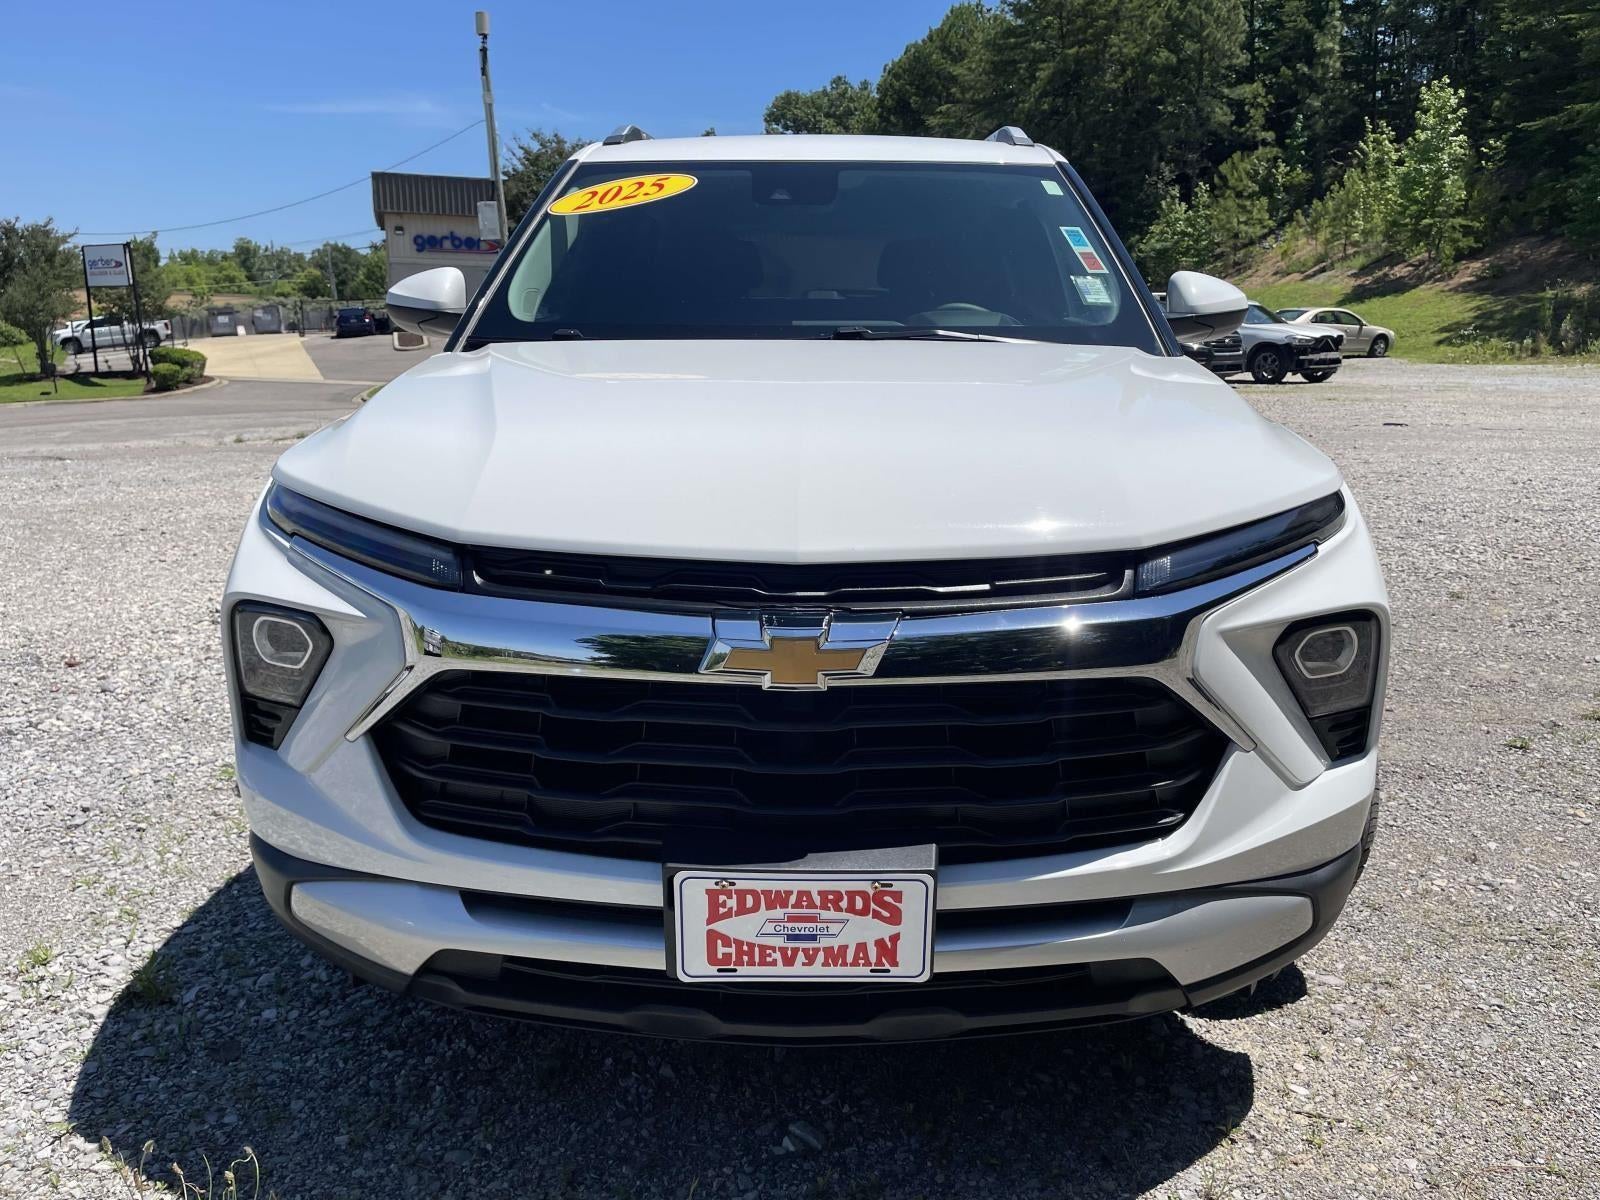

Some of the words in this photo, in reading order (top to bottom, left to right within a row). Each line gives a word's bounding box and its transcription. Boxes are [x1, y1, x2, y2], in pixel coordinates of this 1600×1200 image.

[571, 175, 671, 212] 2025
[705, 888, 903, 927] EDWARDS
[773, 923, 831, 934] Chevrolet
